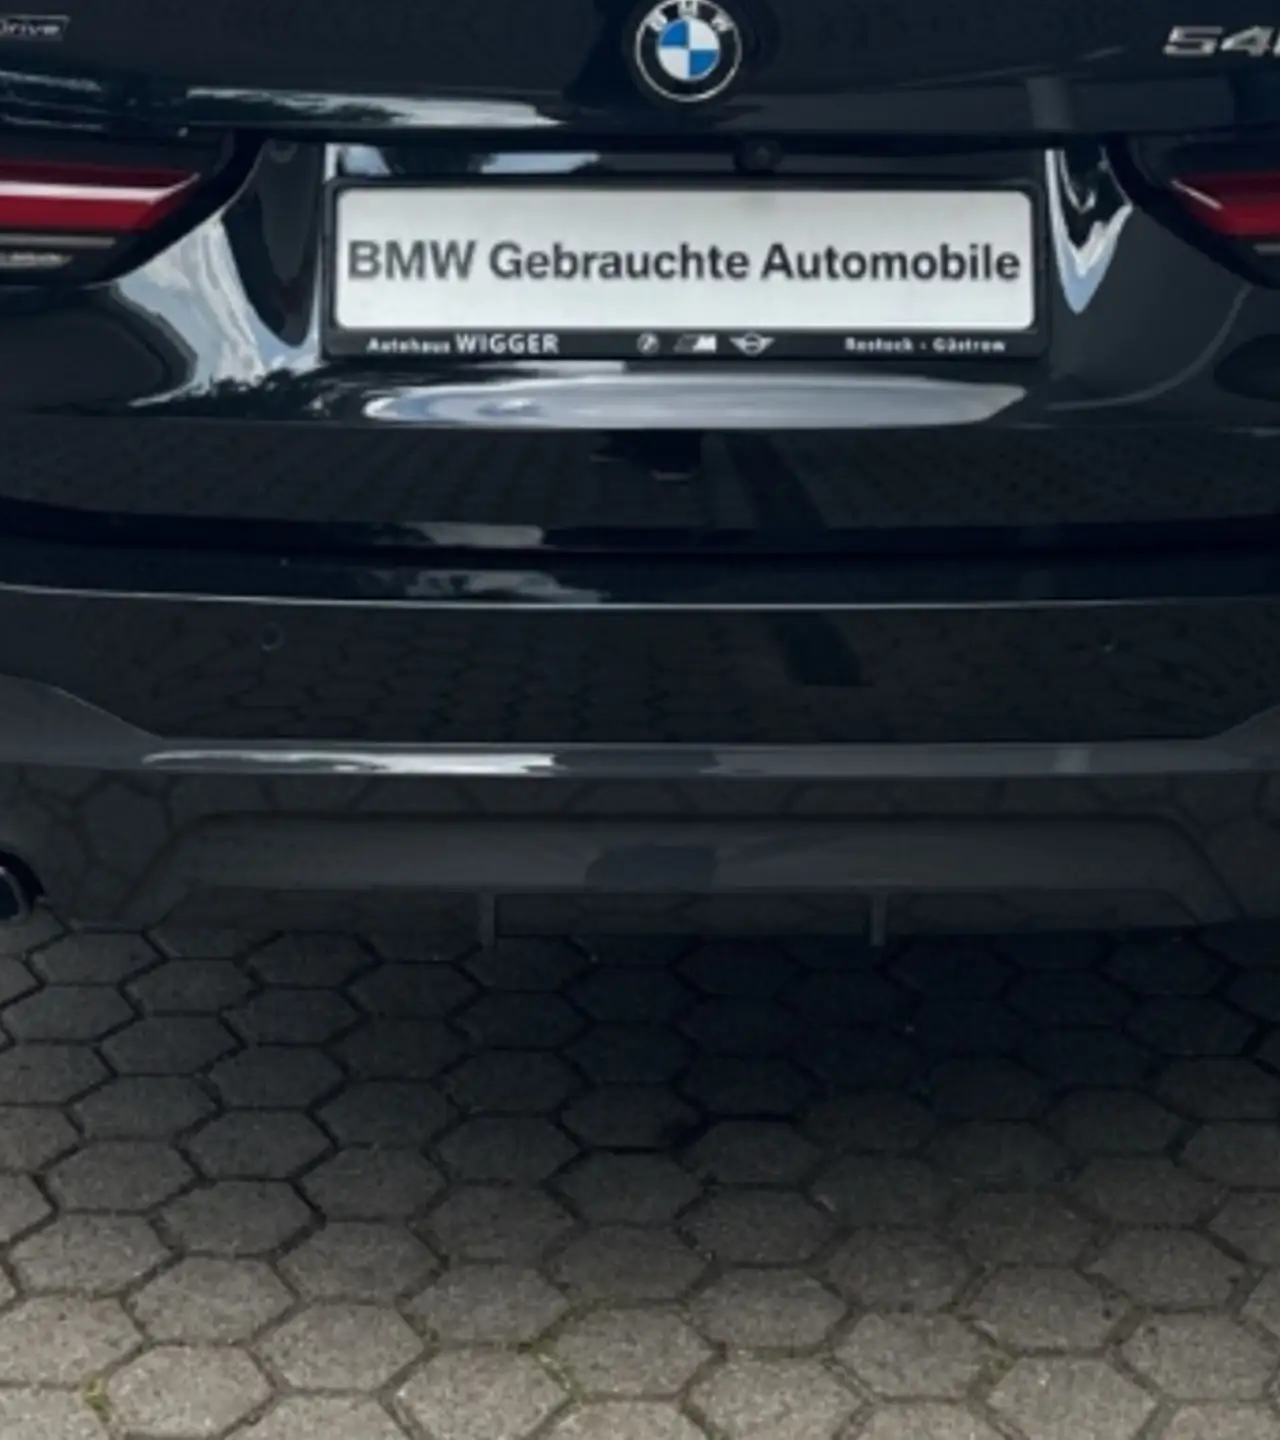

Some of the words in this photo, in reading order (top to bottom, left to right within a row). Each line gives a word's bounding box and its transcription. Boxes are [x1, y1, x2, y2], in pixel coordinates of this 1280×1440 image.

[347, 240, 476, 280] BMW
[488, 240, 751, 280] Gebrauchte
[760, 241, 1021, 280] Automobile
[366, 336, 451, 354] Autohaus
[455, 333, 560, 355] WIGGER
